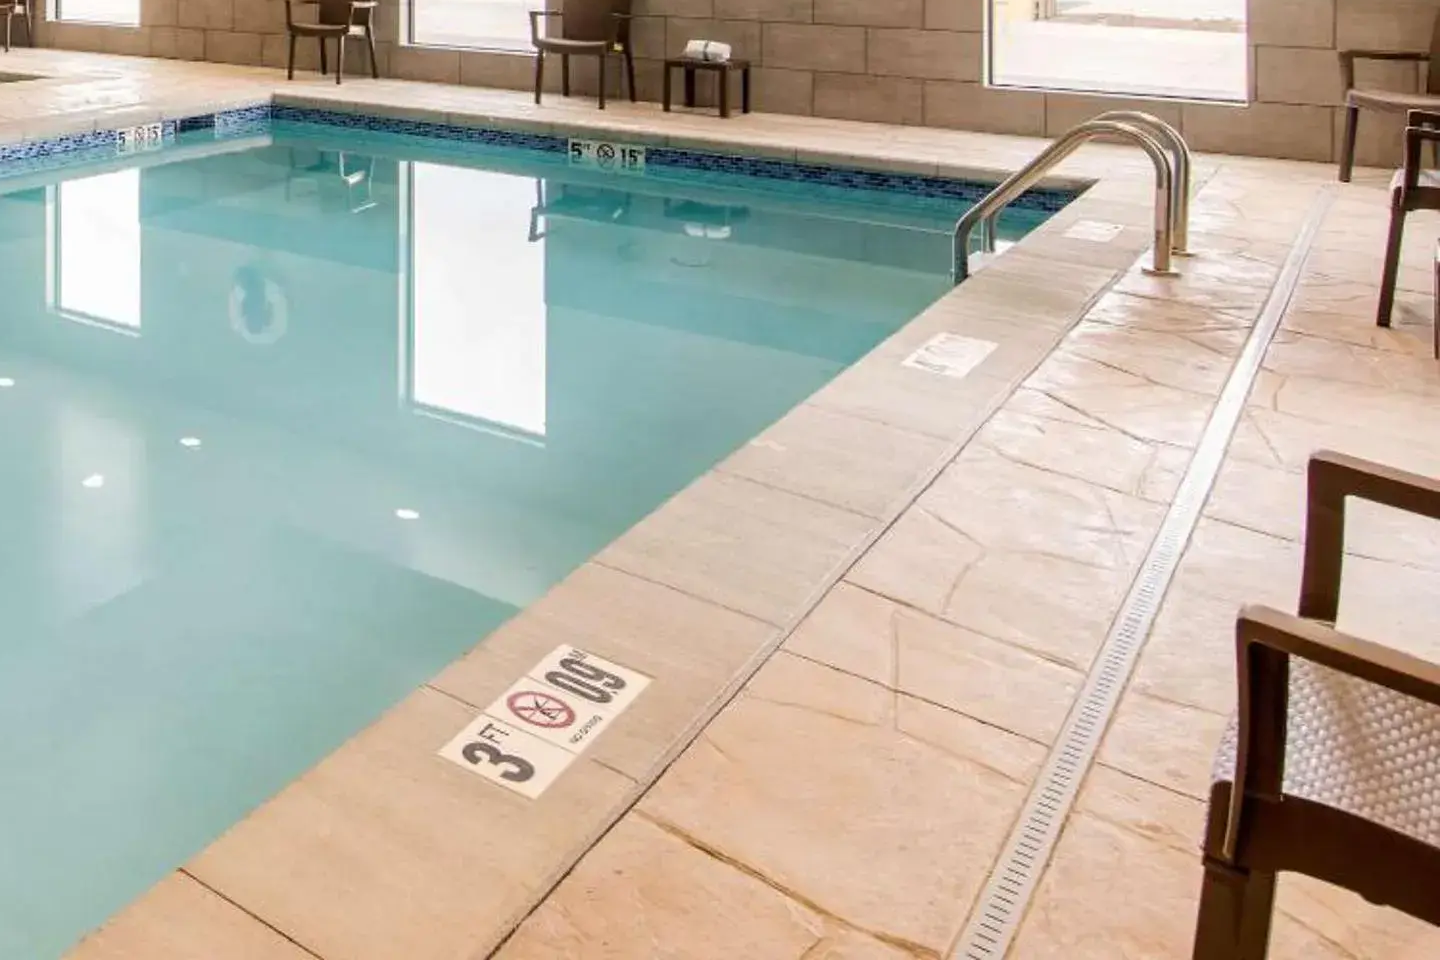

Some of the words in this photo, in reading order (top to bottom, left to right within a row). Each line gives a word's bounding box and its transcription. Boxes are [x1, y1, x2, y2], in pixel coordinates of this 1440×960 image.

[570, 142, 583, 157] 5
[477, 723, 511, 744] FT
[461, 741, 535, 782] 3
